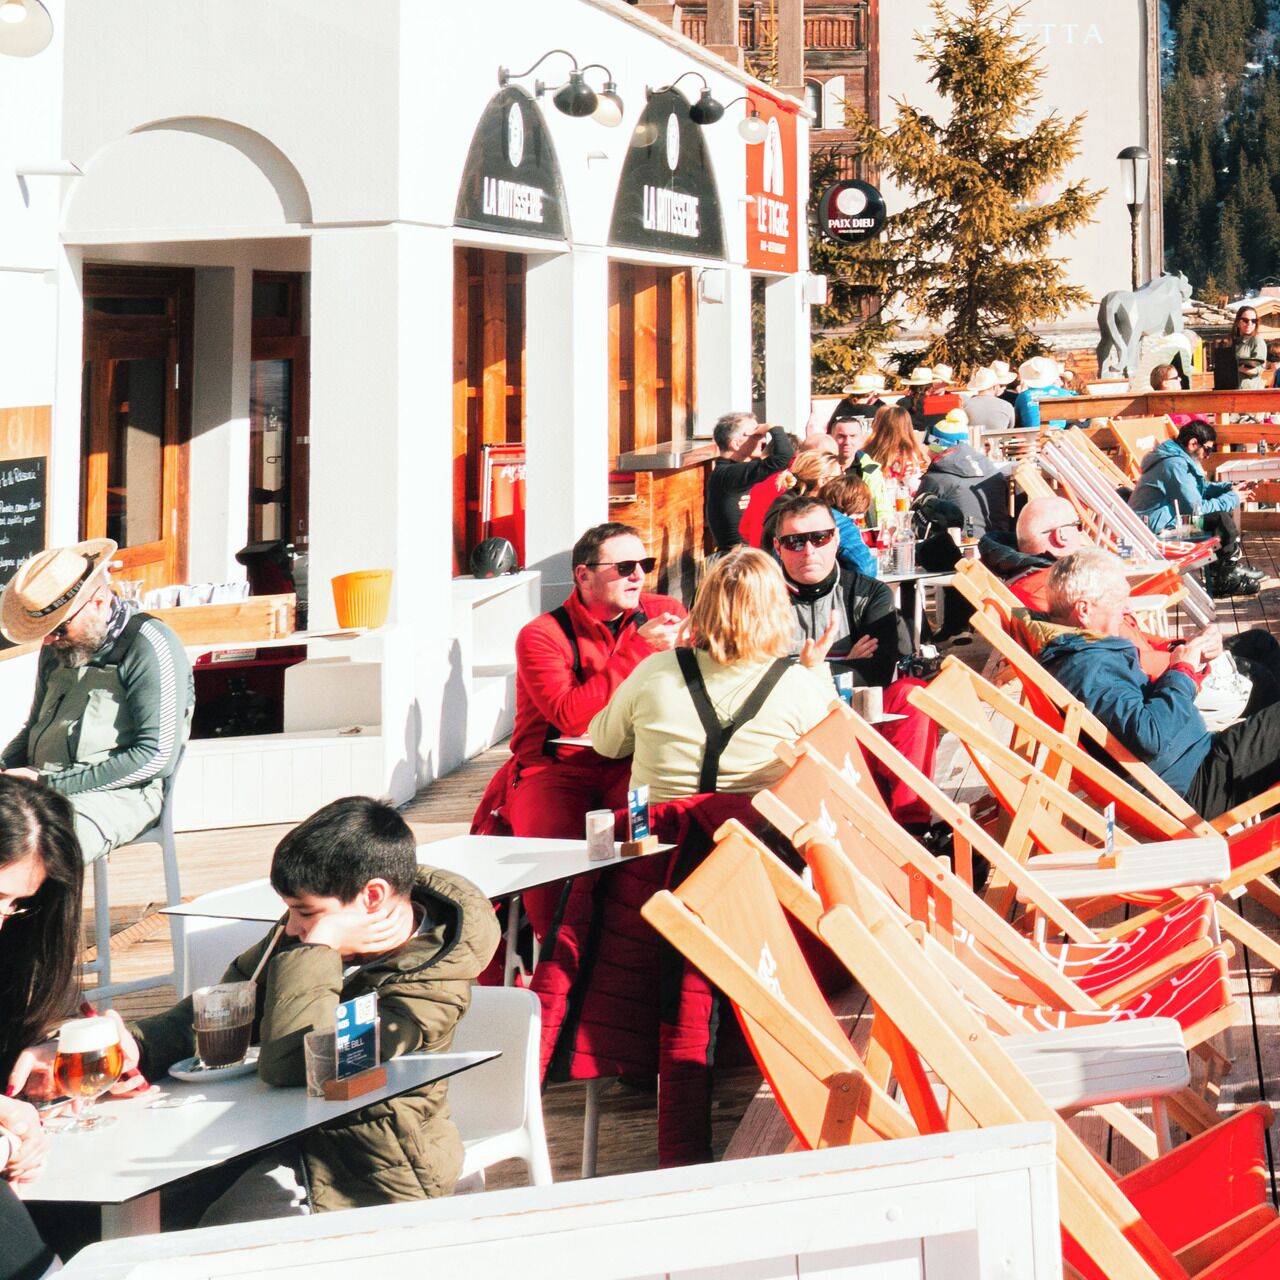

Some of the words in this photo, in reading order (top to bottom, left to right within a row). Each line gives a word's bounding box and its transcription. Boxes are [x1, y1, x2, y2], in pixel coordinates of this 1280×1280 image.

[482, 176, 498, 216] LA
[497, 179, 544, 224] ROTISSERIE
[643, 184, 656, 230] LA
[655, 187, 700, 238] ROTISSERIE
[757, 196, 768, 233] LE
[768, 199, 790, 238] TIGRE
[828, 218, 851, 229] PAIX
[852, 218, 875, 228] DIEU
